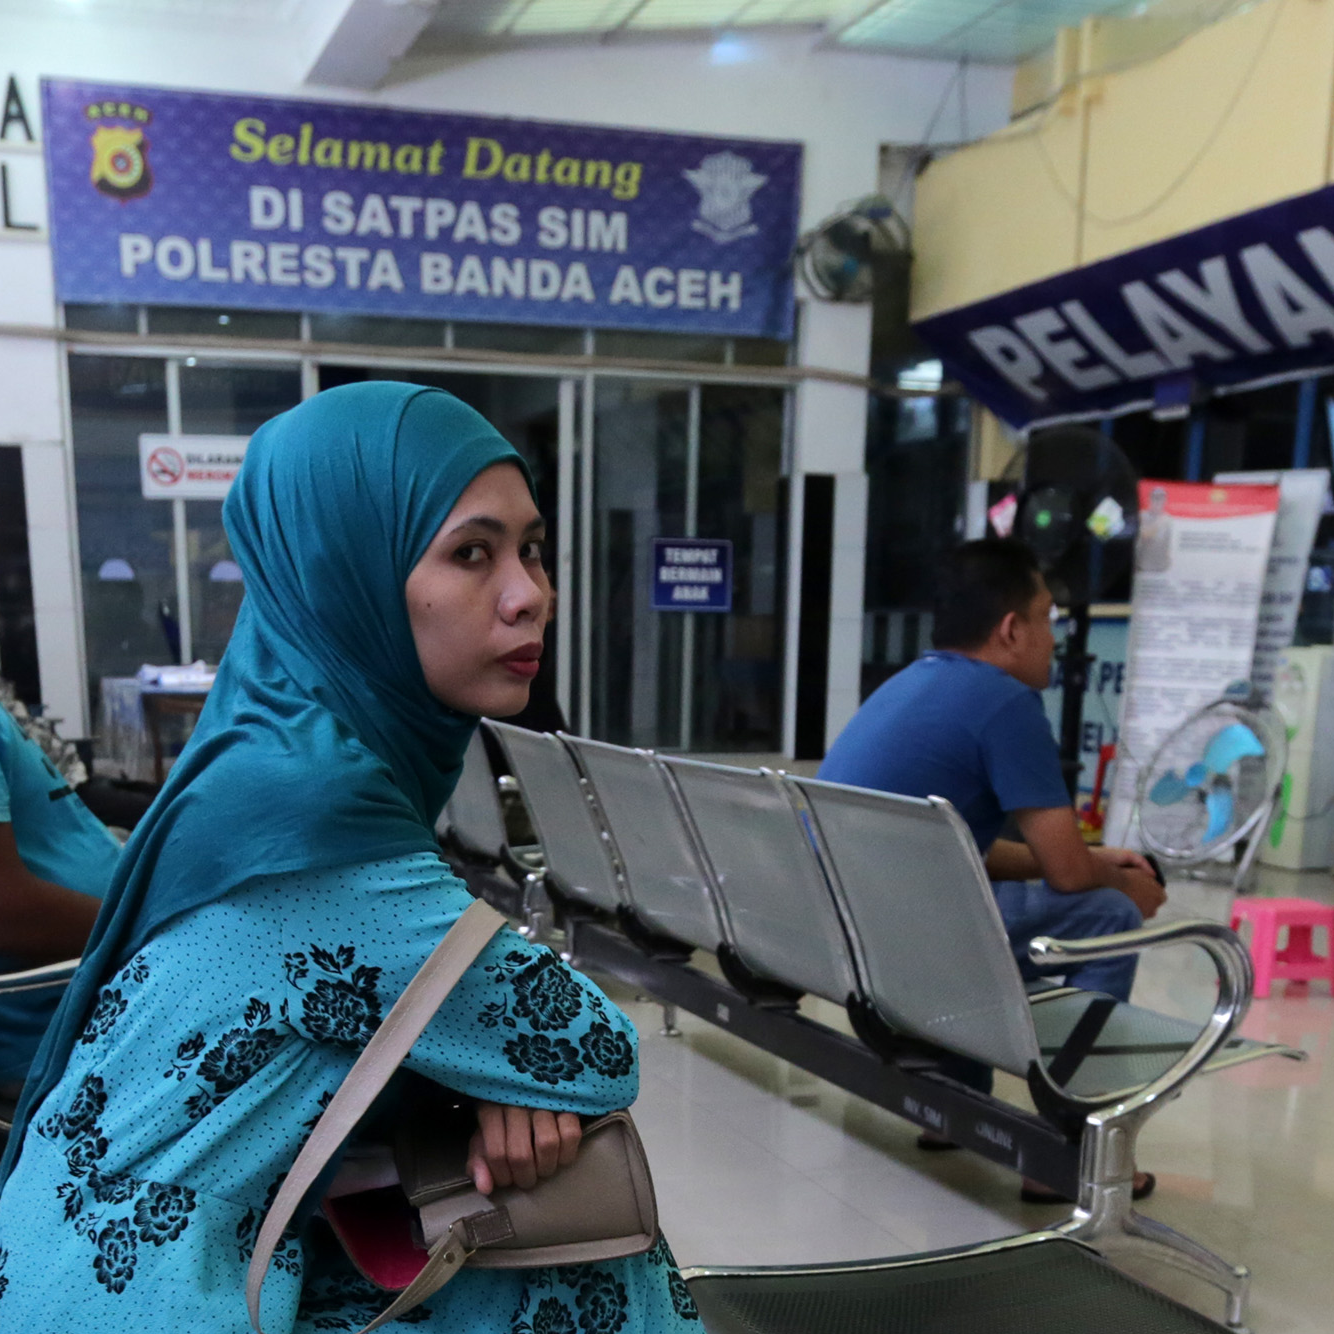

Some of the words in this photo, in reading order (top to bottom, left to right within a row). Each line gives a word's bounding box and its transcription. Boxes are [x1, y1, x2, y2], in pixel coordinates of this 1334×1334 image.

[229, 117, 445, 178] Selamat
[463, 136, 644, 200] Datang
[249, 184, 305, 233] DI
[322, 188, 523, 247] SATPAS
[536, 205, 630, 254] SIM
[119, 233, 406, 294] POLRESTA
[420, 252, 596, 303] BANDA
[609, 266, 743, 312] ACEH
